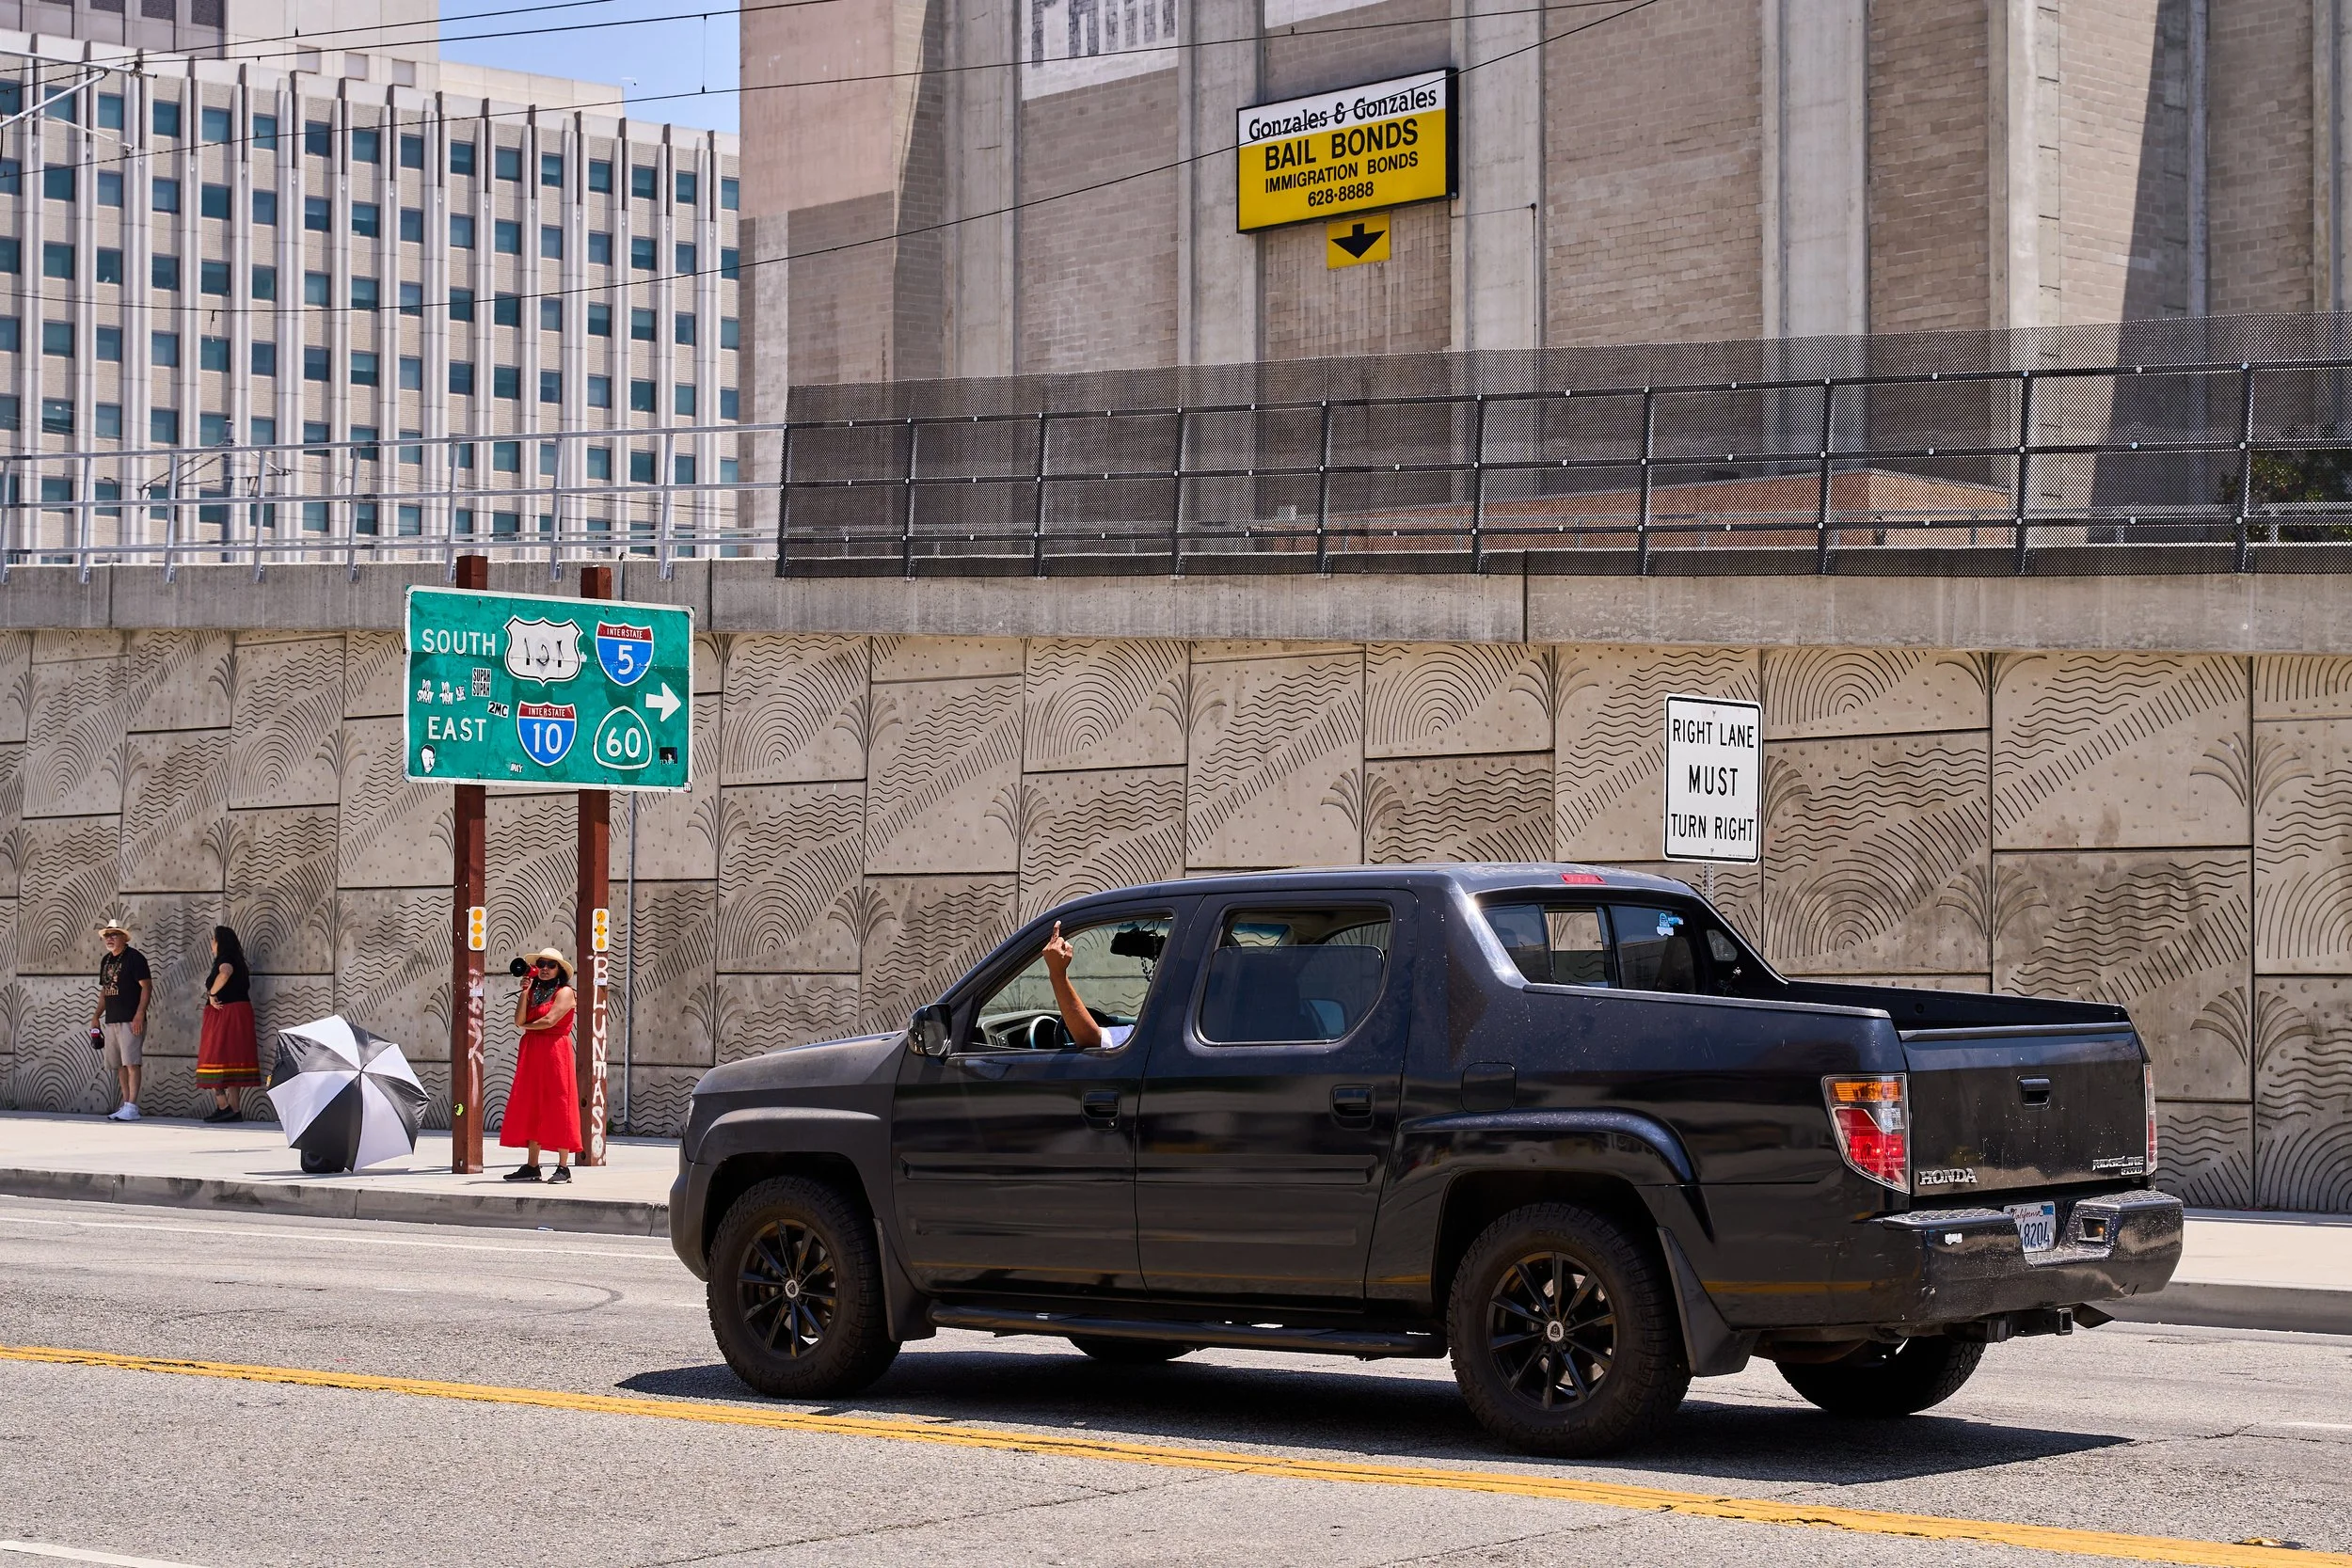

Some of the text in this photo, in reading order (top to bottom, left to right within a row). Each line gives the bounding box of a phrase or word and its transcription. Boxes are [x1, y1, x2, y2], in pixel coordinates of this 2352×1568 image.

[1249, 88, 1437, 140] Gonzales & Gonzales
[1265, 118, 1419, 171] BAIL BONDS
[1265, 151, 1419, 193] IMMIGRATION BONDS
[421, 628, 496, 656] SOUTH
[607, 626, 643, 639] INTERSTATE
[617, 644, 634, 675] 5
[473, 669, 490, 682] SUPAH
[473, 682, 489, 695] SUPAH
[489, 702, 508, 717] 2MC
[528, 706, 565, 718] INTERSTATE
[428, 716, 487, 742] EAST
[533, 722, 563, 754] 10
[606, 727, 642, 758] 60
[1673, 719, 1755, 748] RIGHT LANE
[1689, 764, 1739, 796] MUST
[1671, 813, 1754, 841] TURN RIGHT
[1919, 1167, 1978, 1185] HONDA
